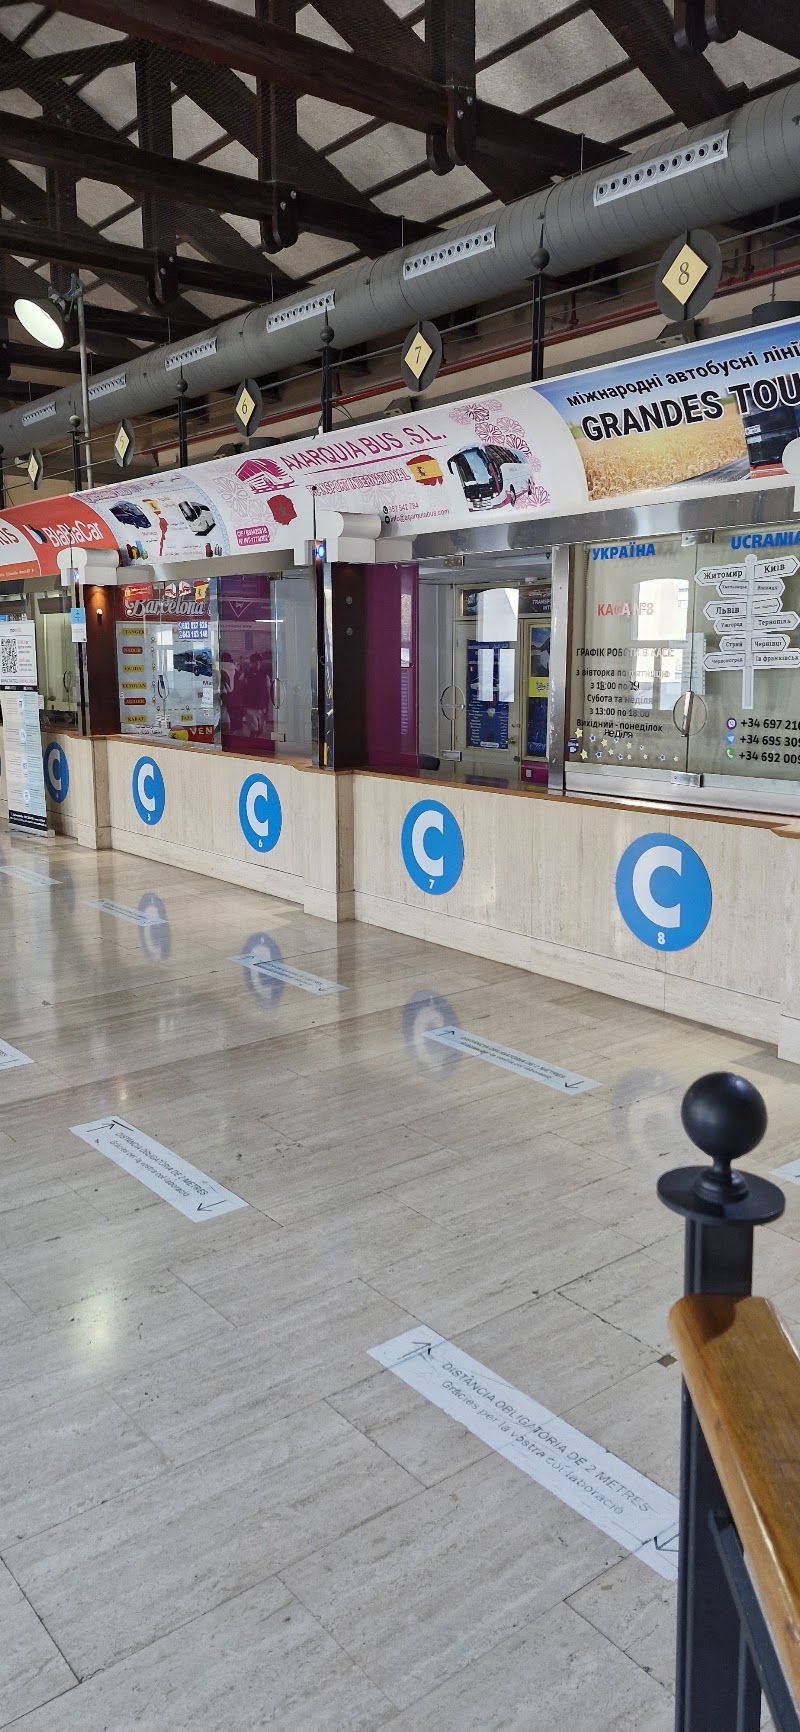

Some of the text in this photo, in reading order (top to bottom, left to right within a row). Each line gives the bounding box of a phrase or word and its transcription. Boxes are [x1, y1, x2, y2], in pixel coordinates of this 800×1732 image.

[678, 261, 690, 286] 8
[414, 345, 422, 364] 7
[566, 373, 663, 407] міжнародні
[665, 351, 759, 385] автобусні
[241, 401, 248, 415] 6
[582, 390, 724, 442] GRANDES
[119, 435, 125, 449] 5
[279, 440, 366, 471] AXARQUIA
[358, 432, 403, 455] BUS
[348, 468, 411, 490] INTERNATIONAL
[41, 520, 104, 547] BlaBlaCar
[592, 541, 656, 560] УКРАЇНА
[703, 569, 743, 580] Житомир
[763, 563, 785, 573] Київ
[125, 596, 205, 618] Barcelona
[597, 603, 631, 616] КАСА
[715, 604, 740, 615] Львів
[758, 618, 791, 626] Тернопіль
[754, 640, 782, 648] Чернівці
[576, 648, 605, 657] ГРАФІК
[606, 648, 641, 657] РОБОТИ
[582, 668, 615, 677] вівторка
[617, 669, 627, 677] по
[587, 693, 612, 703] Субота
[624, 695, 653, 705] неділя
[595, 707, 615, 716] 13:00
[617, 709, 627, 717] по
[628, 709, 650, 718] 18:00
[576, 719, 614, 729] Вихідний
[620, 722, 663, 732] понеділок
[741, 718, 760, 728] +34
[763, 718, 782, 729] 697
[740, 734, 759, 745] +34
[762, 735, 781, 746] 695
[739, 751, 758, 761] +34
[761, 752, 780, 762] 692
[47, 749, 62, 791] C
[137, 763, 155, 812] C
[246, 781, 269, 837] C
[147, 813, 151, 821] 5
[258, 839, 263, 848] 6
[411, 809, 444, 877] C
[428, 879, 435, 890] 7
[632, 845, 682, 928] C
[657, 932, 666, 945] 8
[476, 1409, 498, 1422] per
[498, 1421, 511, 1432] la
[566, 1451, 588, 1466] DE
[585, 1464, 597, 1473] 2
[595, 1471, 648, 1512] METRES
